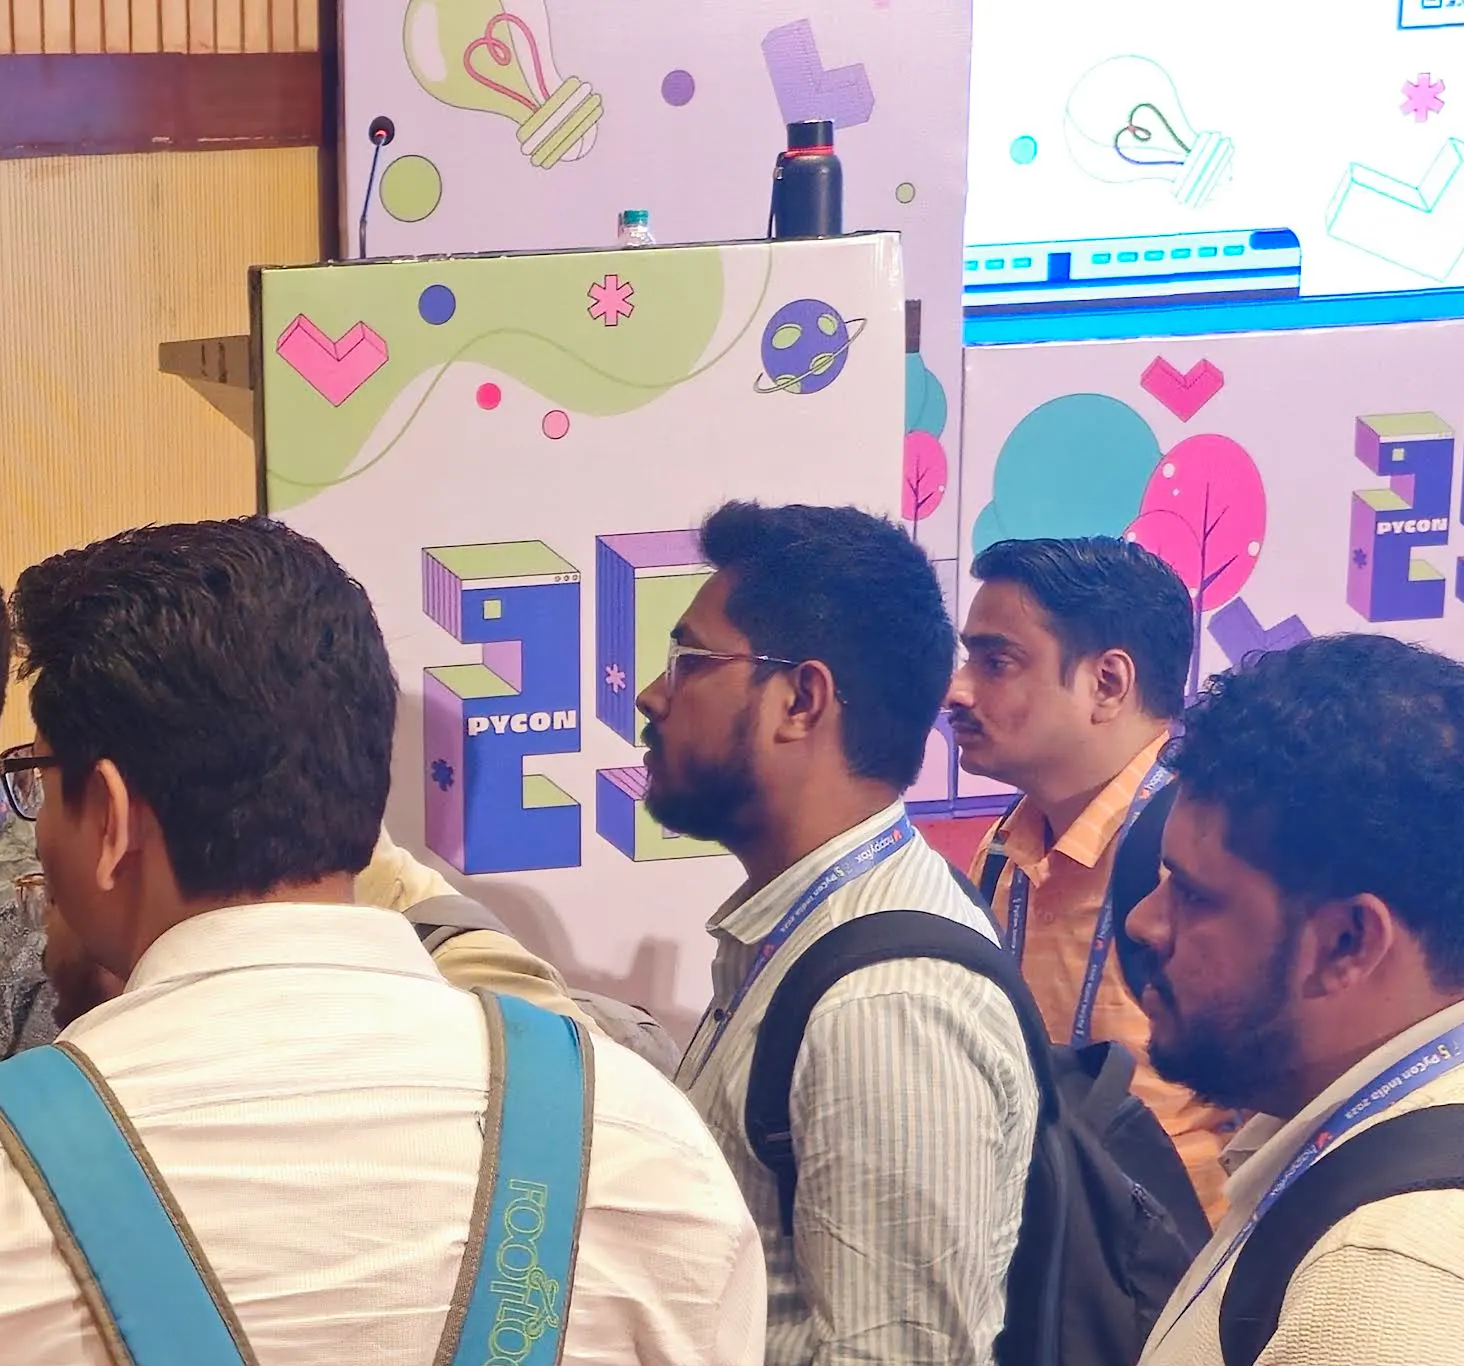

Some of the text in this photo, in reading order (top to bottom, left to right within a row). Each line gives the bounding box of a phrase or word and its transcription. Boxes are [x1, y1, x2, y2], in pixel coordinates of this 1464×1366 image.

[1376, 518, 1448, 535] PYCON
[467, 710, 577, 736] PYCON
[855, 836, 896, 864] happyfox
[1403, 1054, 1440, 1080] PyCon
[1372, 1076, 1403, 1100] India
